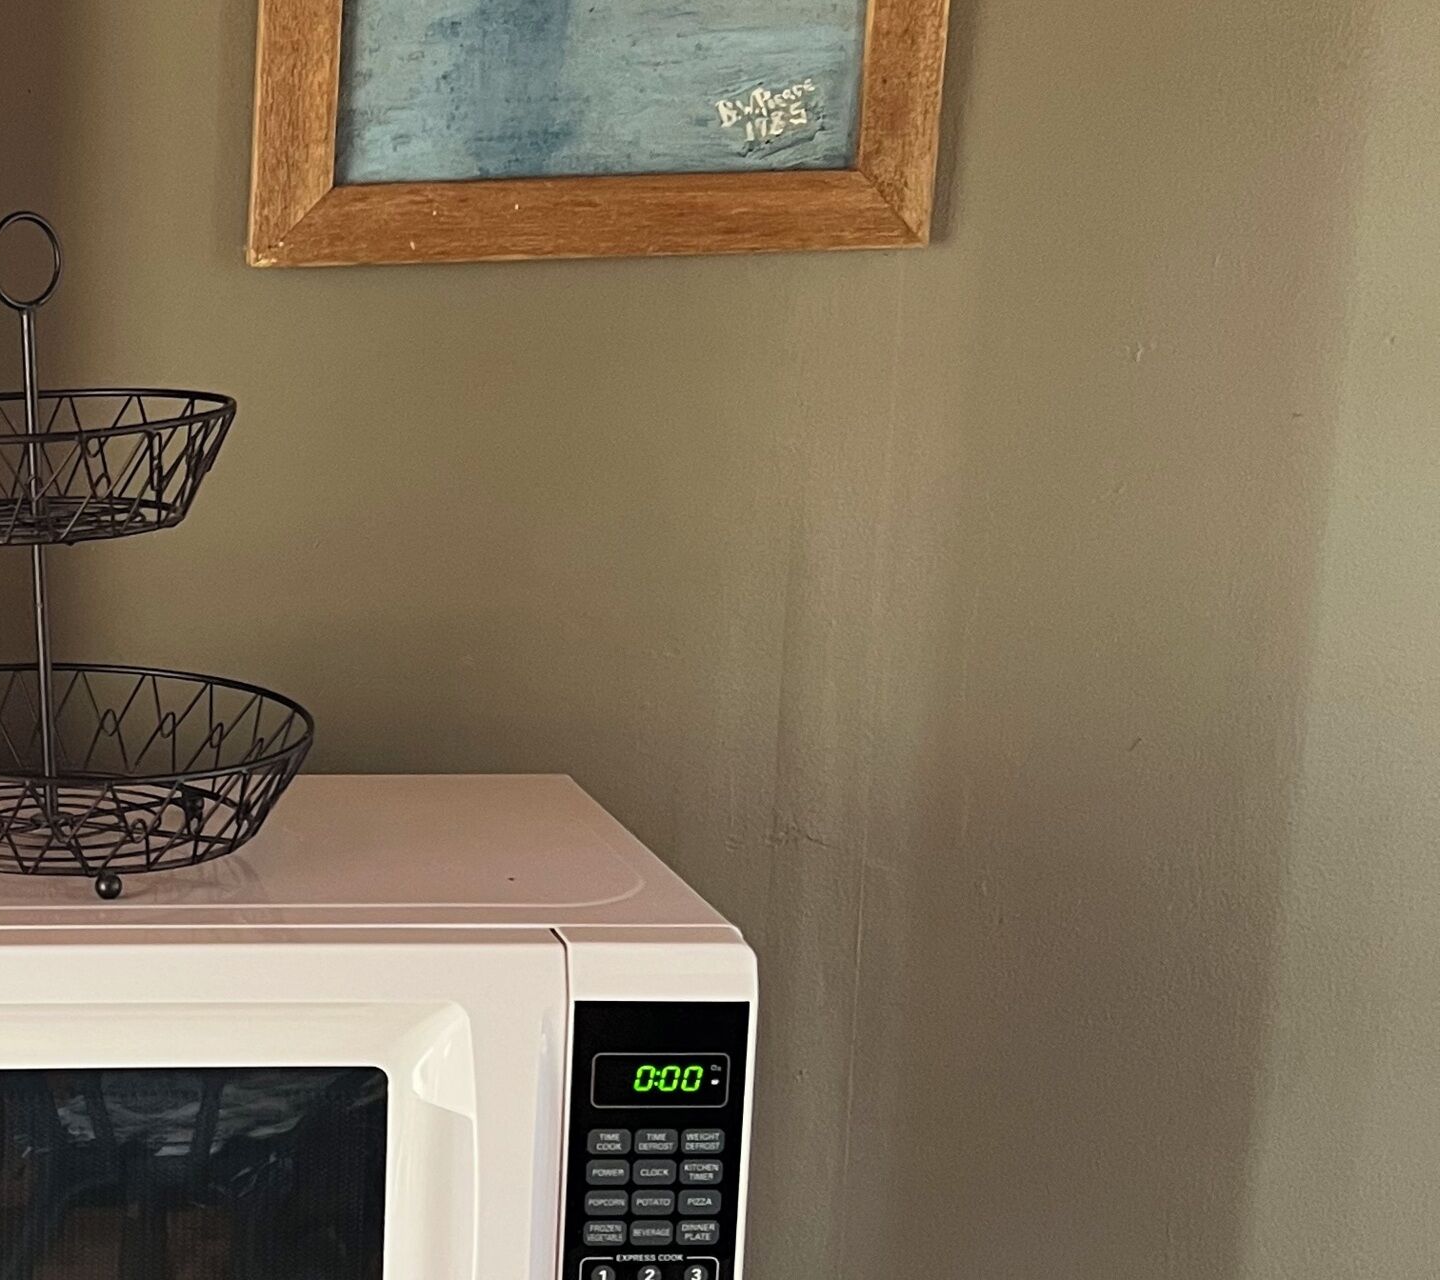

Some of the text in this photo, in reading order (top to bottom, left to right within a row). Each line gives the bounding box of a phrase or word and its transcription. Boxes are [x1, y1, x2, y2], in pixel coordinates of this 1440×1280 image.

[633, 1065, 704, 1092] 0:00
[599, 1133, 620, 1141] TIME
[646, 1133, 667, 1141] TIME
[685, 1132, 720, 1141] WEIGHT
[596, 1143, 622, 1151] COOK
[638, 1142, 674, 1150] DEFROST
[685, 1142, 720, 1150] DEFROST
[684, 1163, 719, 1172] KITCHEN
[592, 1168, 624, 1177] POWER
[640, 1168, 669, 1177] CLOCK
[689, 1172, 714, 1180] TIMER
[588, 1198, 625, 1206] POPCORN
[636, 1198, 671, 1206] POTATO
[687, 1198, 712, 1206] PIZZA
[589, 1224, 622, 1232] FROZEN
[681, 1223, 715, 1231] DINNER
[633, 1228, 670, 1237] BEVERAGE
[684, 1232, 711, 1240] PLATE
[616, 1254, 684, 1262] EXPRESS COOK
